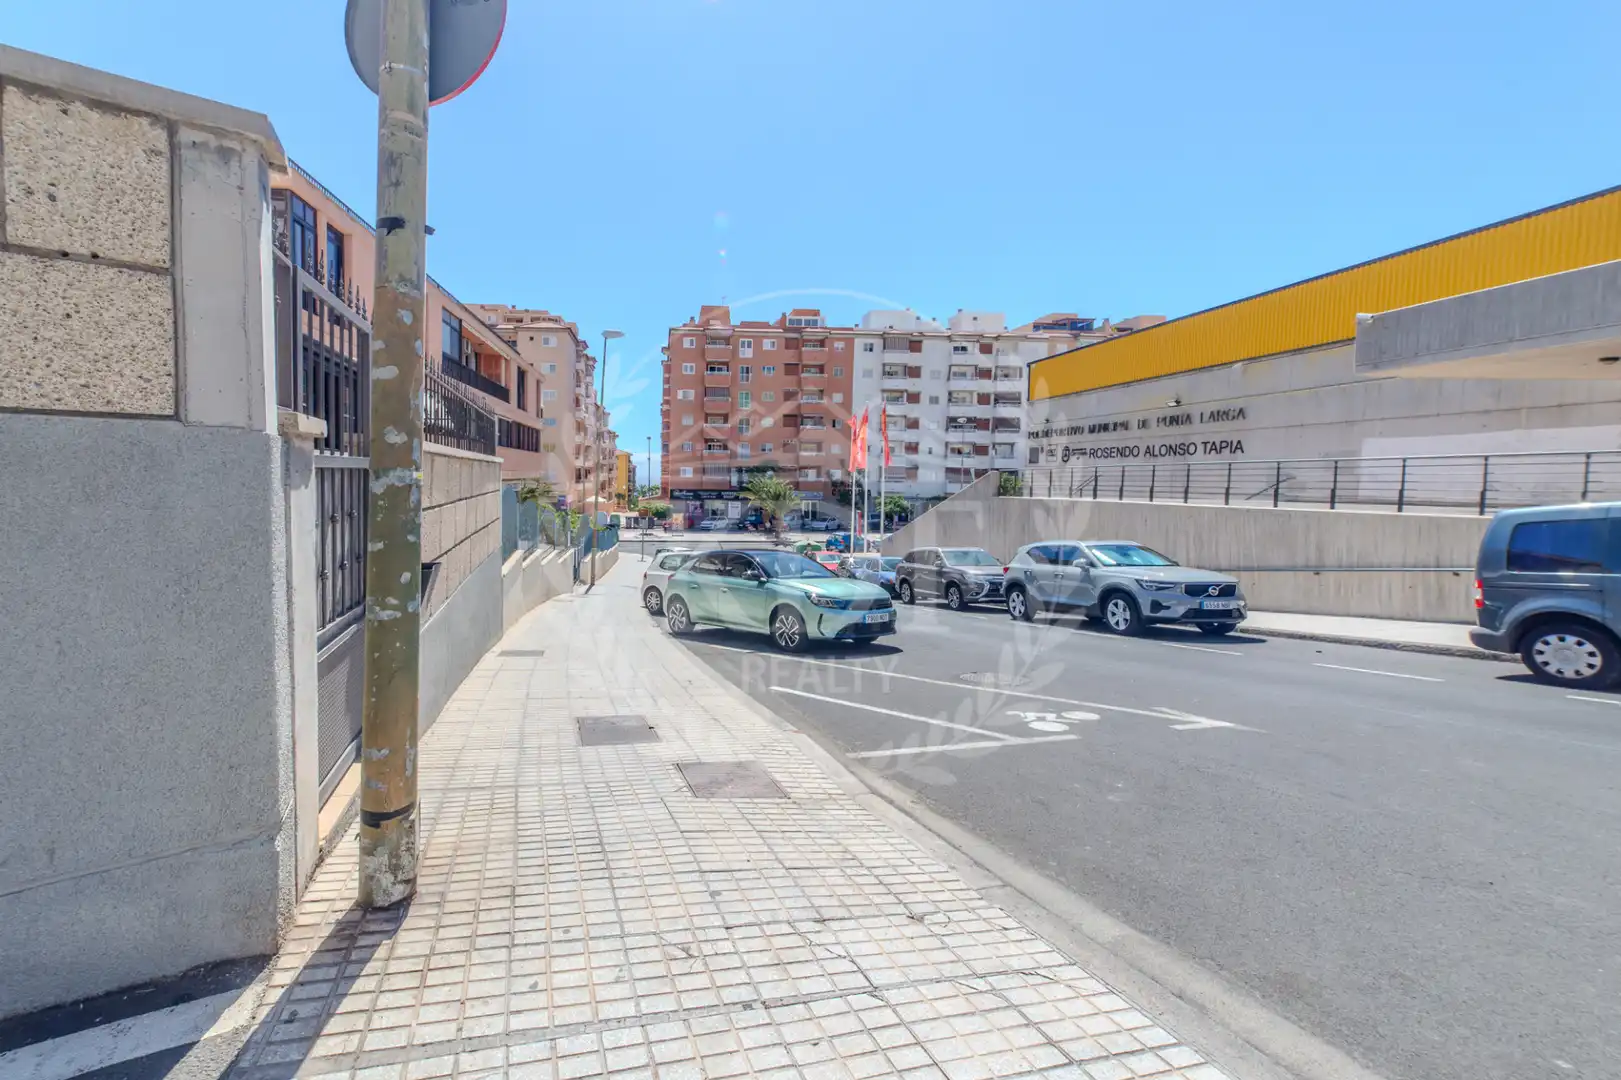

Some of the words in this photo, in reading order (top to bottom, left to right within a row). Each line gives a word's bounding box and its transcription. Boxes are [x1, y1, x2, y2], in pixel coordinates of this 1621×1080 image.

[1138, 418, 1150, 430] DE
[1157, 412, 1193, 428] PUNTA
[1200, 407, 1246, 423] LARGA
[1089, 445, 1140, 459] ROSENDO
[1144, 442, 1198, 458] ALONSO
[1201, 440, 1245, 455] TAPIA
